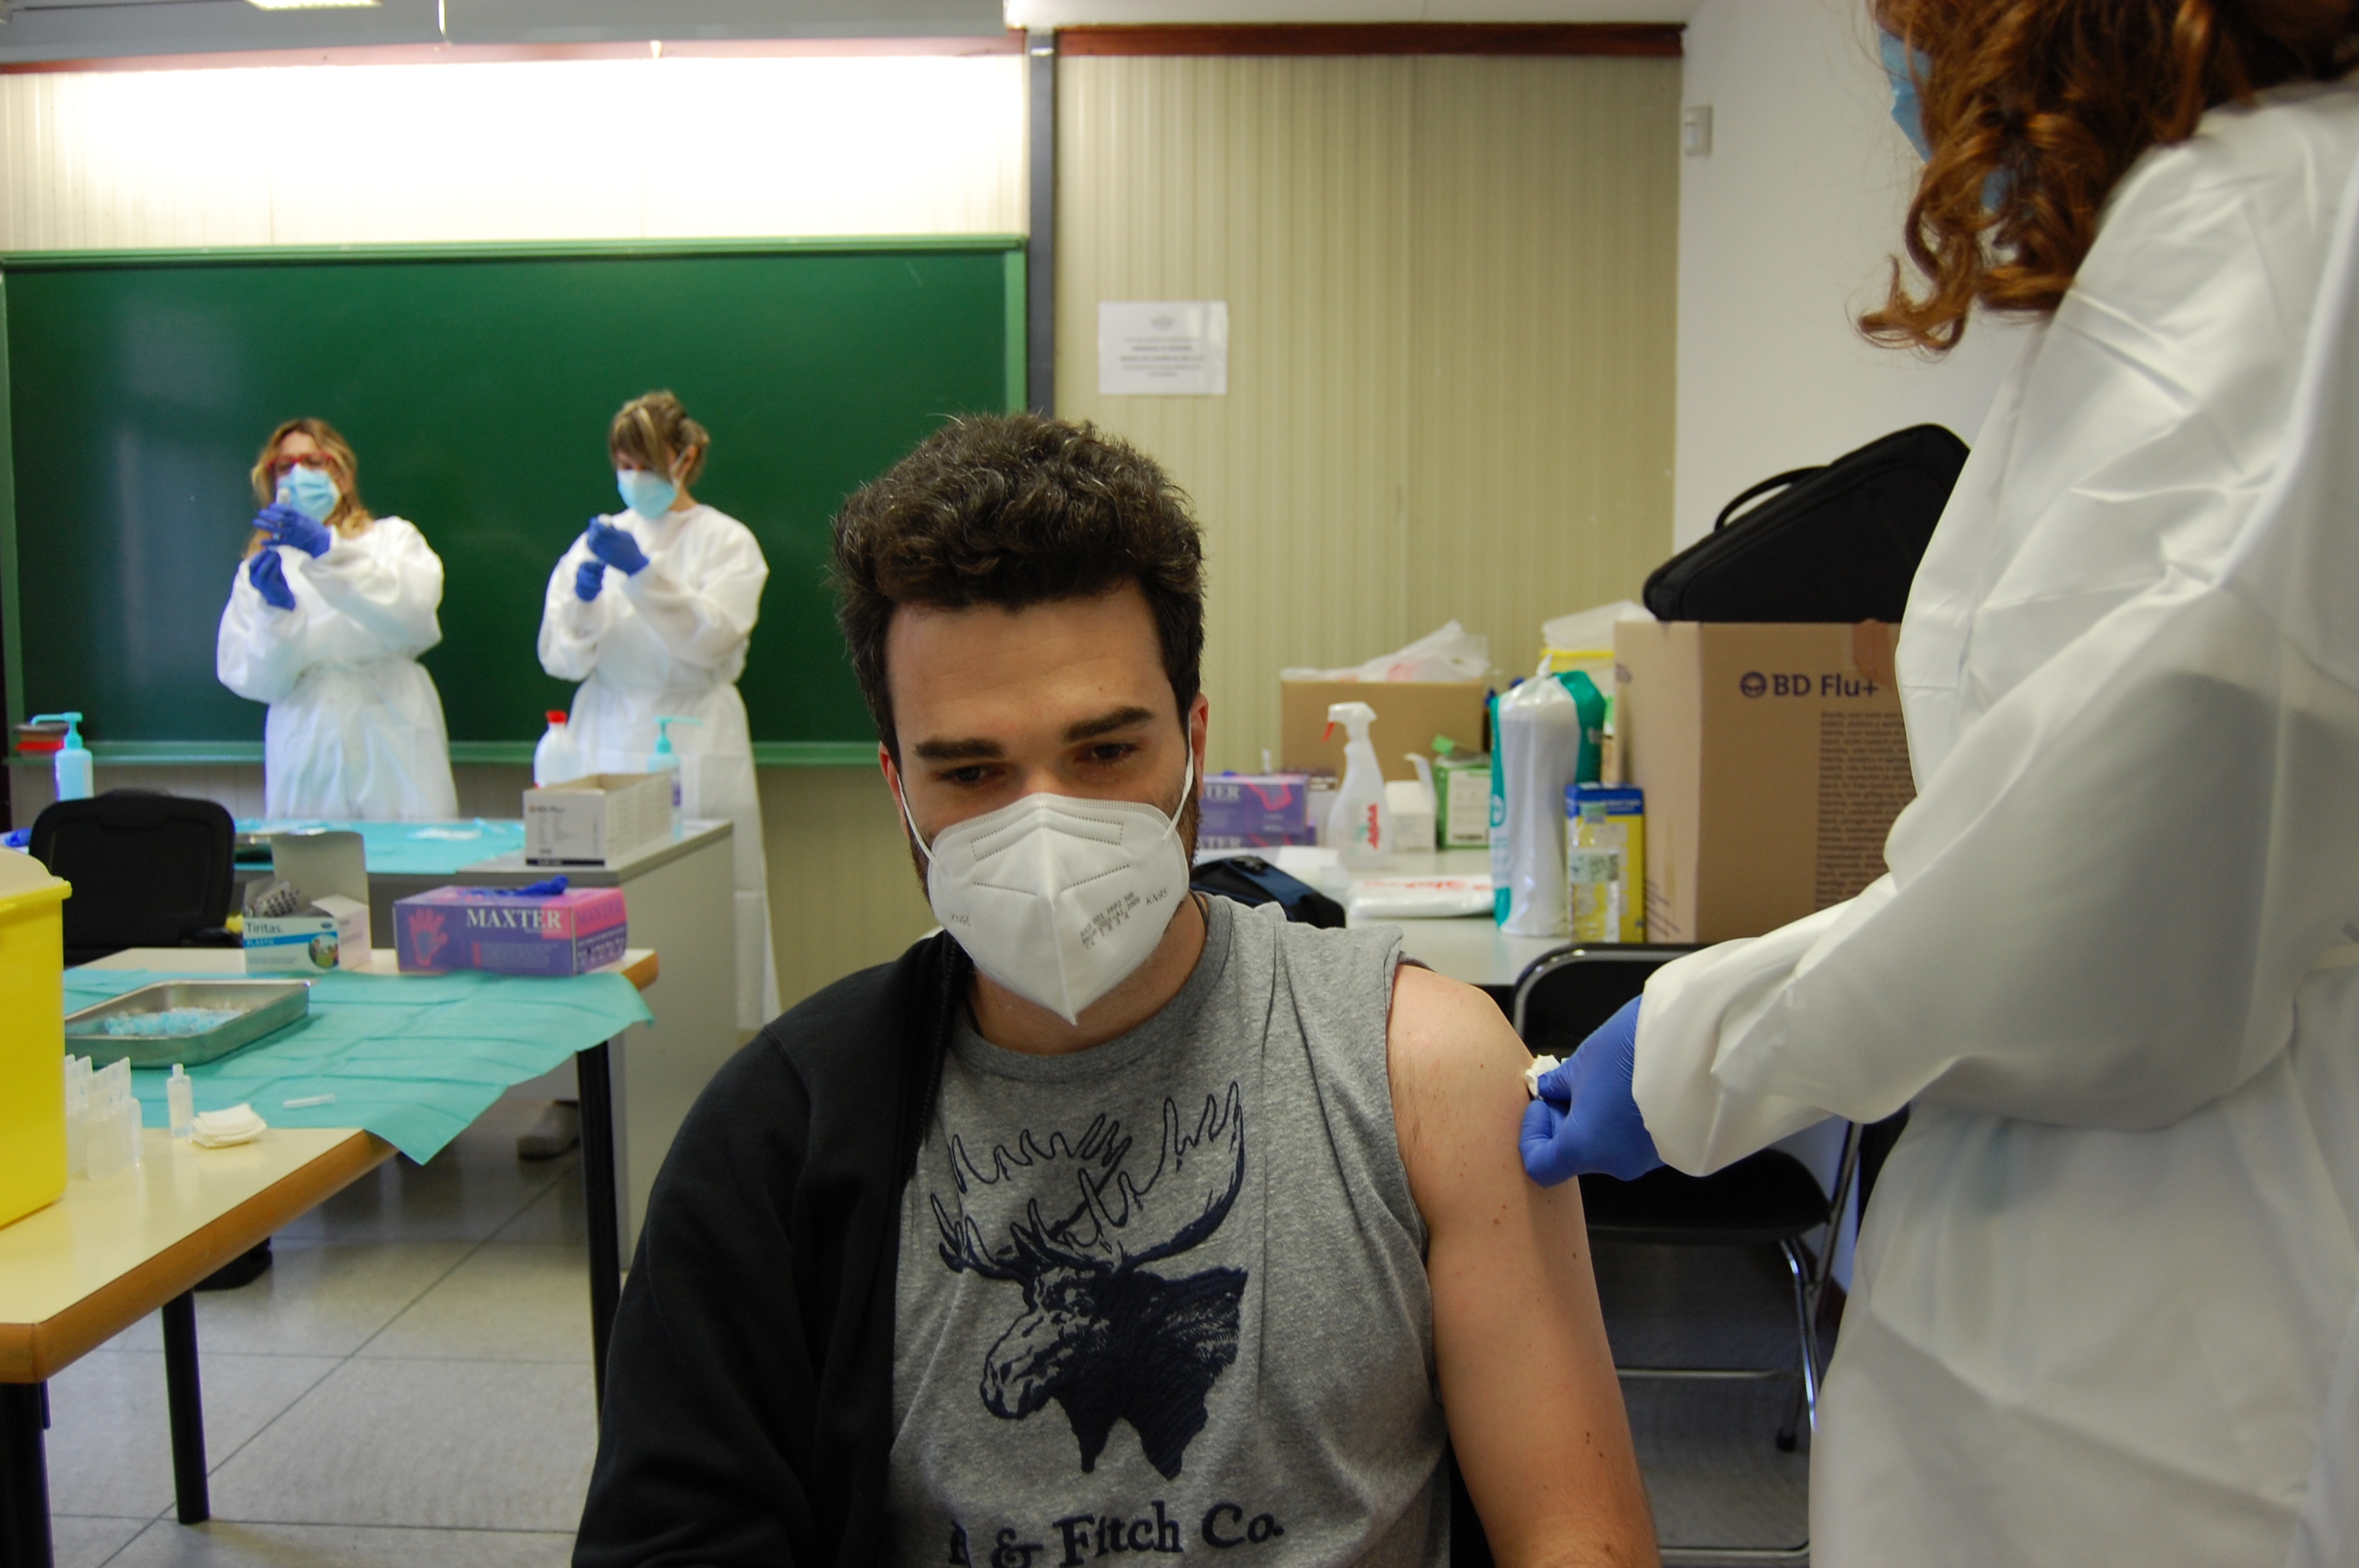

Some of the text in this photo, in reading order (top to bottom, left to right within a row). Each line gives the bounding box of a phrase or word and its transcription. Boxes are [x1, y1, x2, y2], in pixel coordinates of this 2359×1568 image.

[1773, 673, 1878, 696] BD Flu+
[1205, 785, 1240, 802] TER
[467, 909, 563, 929] MAXTER
[991, 1526, 1045, 1568] &
[1052, 1500, 1183, 1567] Fitch
[1201, 1501, 1285, 1549] Co.
